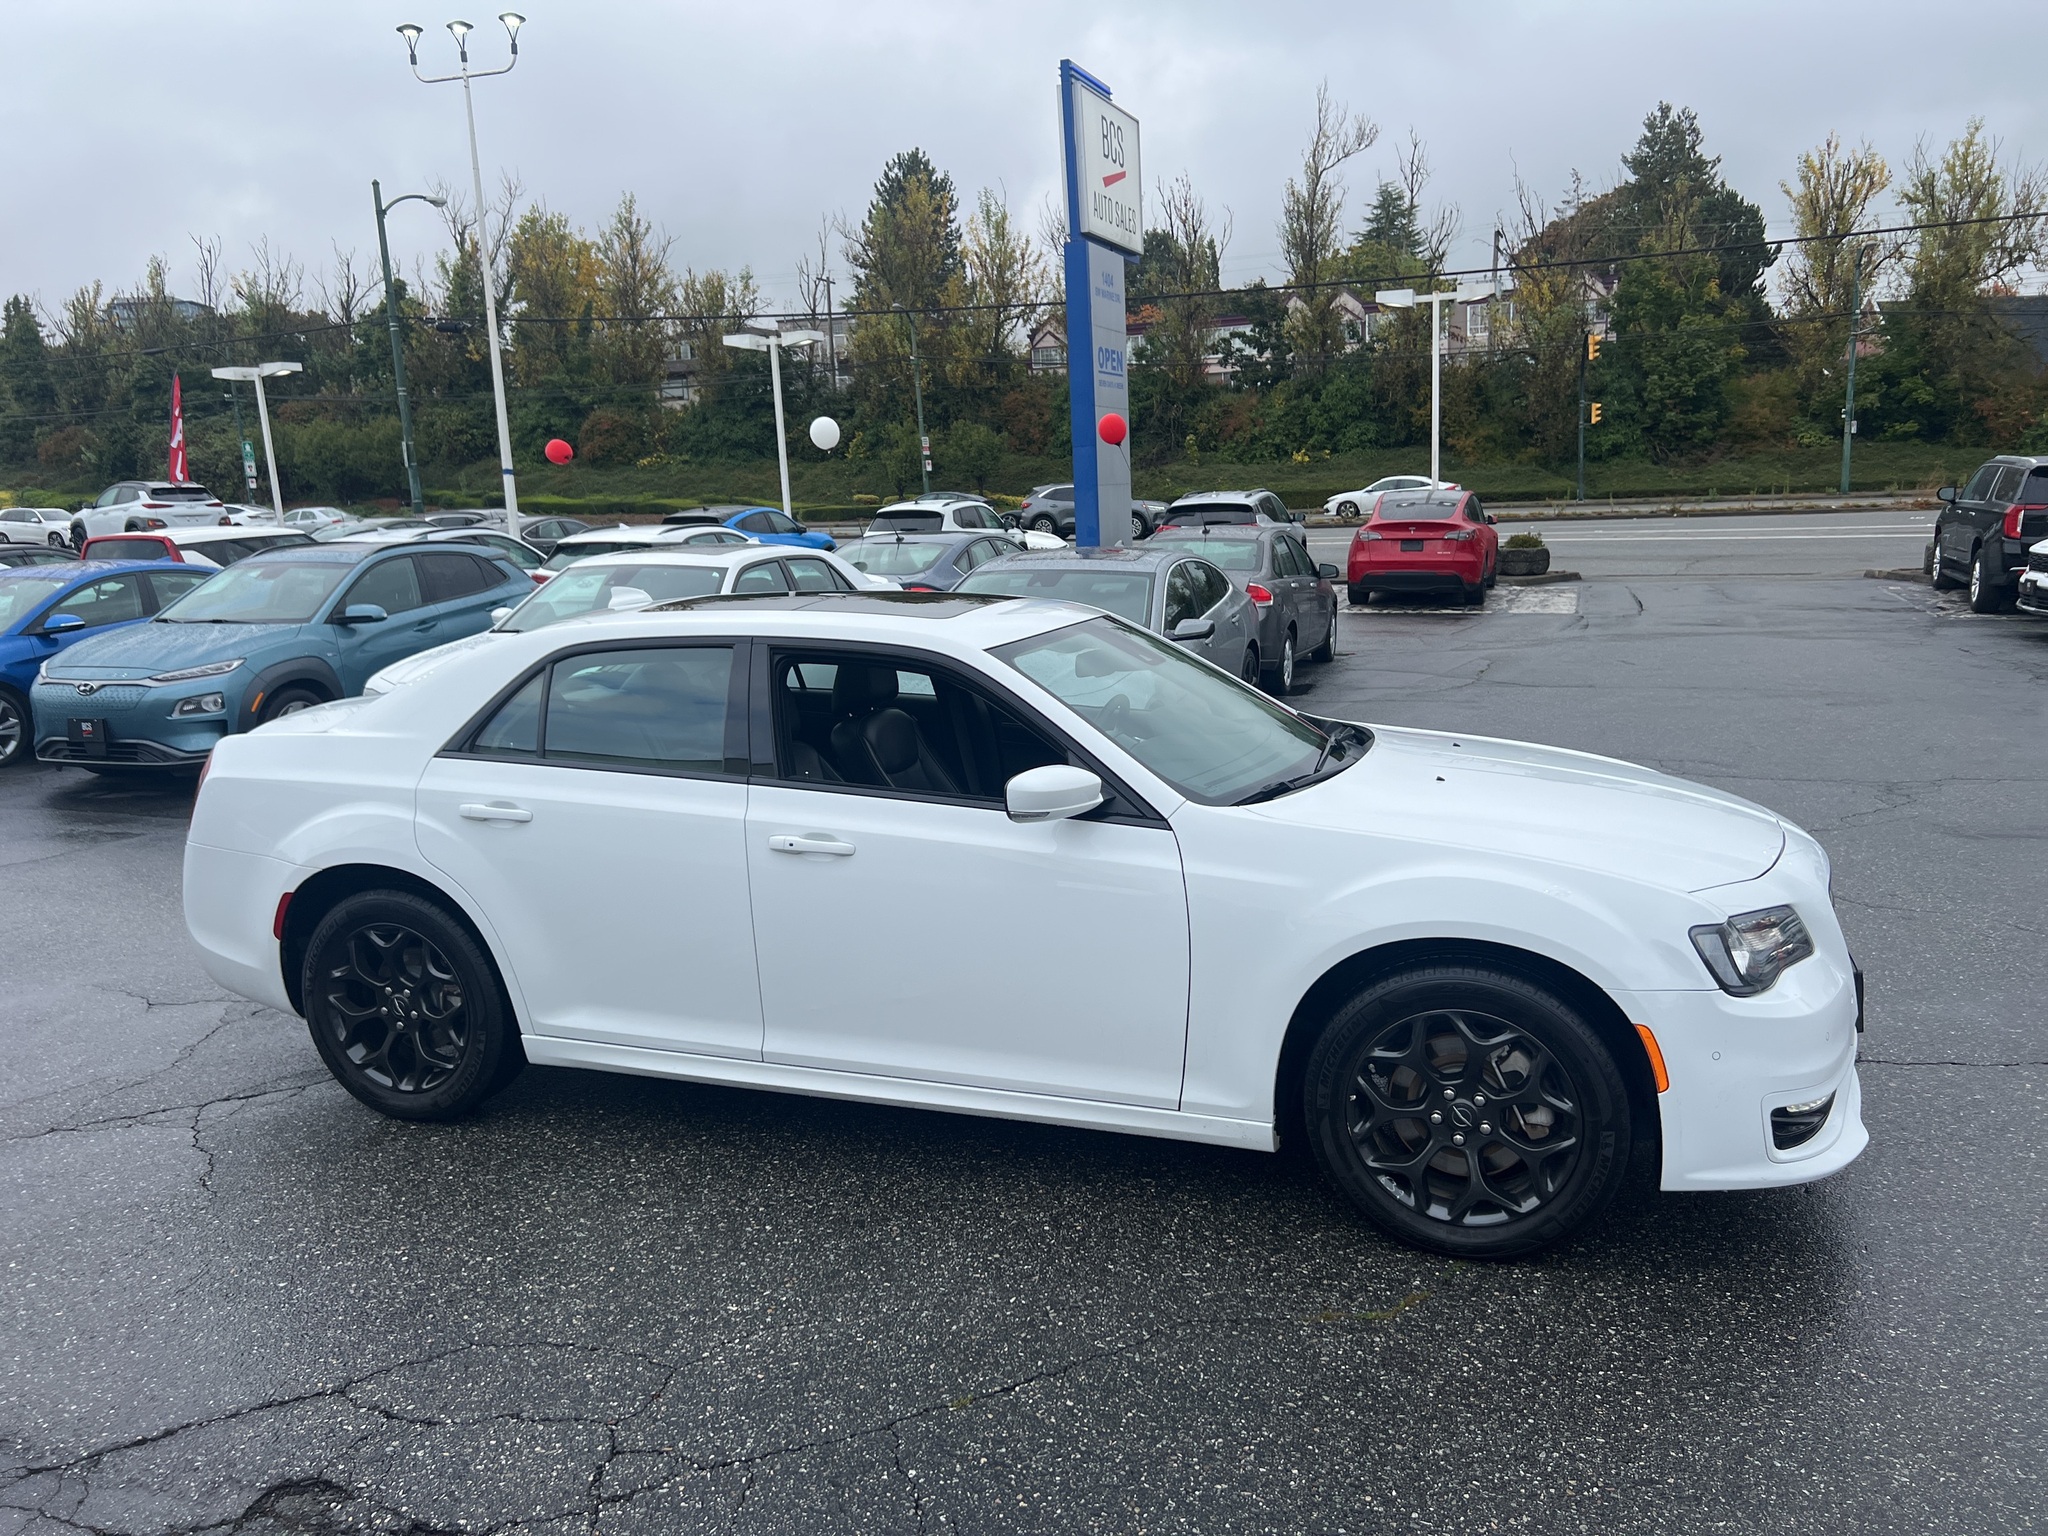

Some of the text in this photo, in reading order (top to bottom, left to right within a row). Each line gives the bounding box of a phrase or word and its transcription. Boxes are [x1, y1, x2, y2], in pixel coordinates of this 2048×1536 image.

[1101, 114, 1125, 168] BCS
[1093, 190, 1136, 235] AUTO SALES
[1098, 346, 1123, 372] OPEN
[1320, 1016, 1362, 1090] MICHELIN
